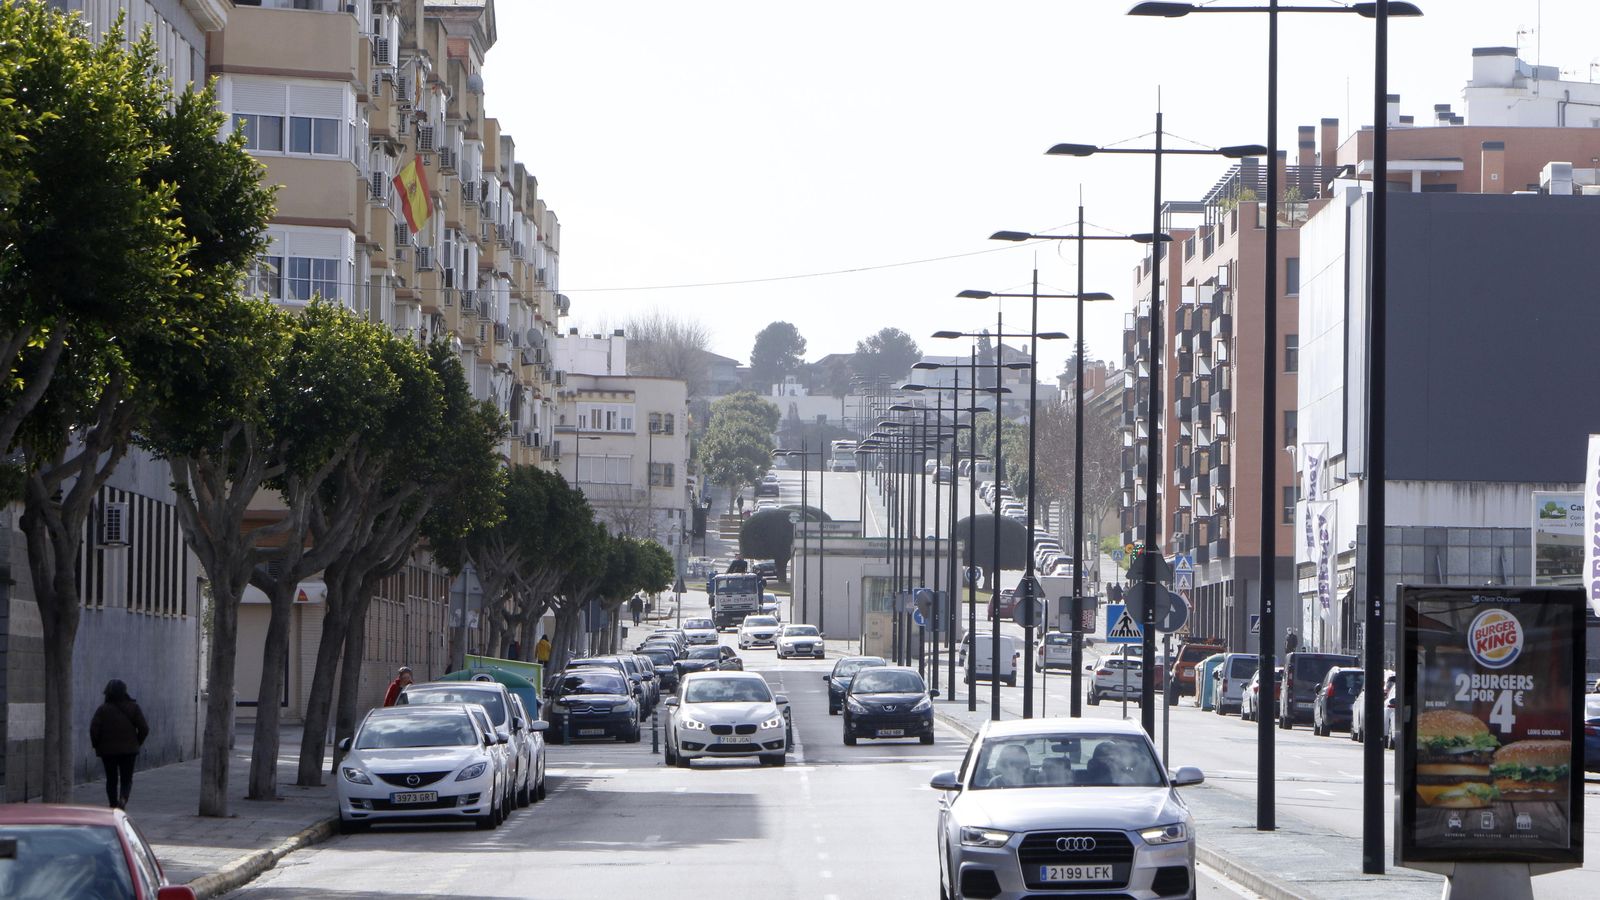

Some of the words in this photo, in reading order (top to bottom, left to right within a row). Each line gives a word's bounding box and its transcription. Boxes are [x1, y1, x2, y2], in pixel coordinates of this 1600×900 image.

[1475, 621, 1515, 640] BURGER
[1476, 630, 1517, 654] KING
[1455, 673, 1471, 701] 2
[1471, 674, 1534, 690] BURGERS
[1471, 690, 1494, 702] POR
[396, 793, 418, 802] 3973
[420, 792, 435, 801] GRT
[1050, 867, 1082, 880] 2199
[1086, 866, 1110, 879] LFK
